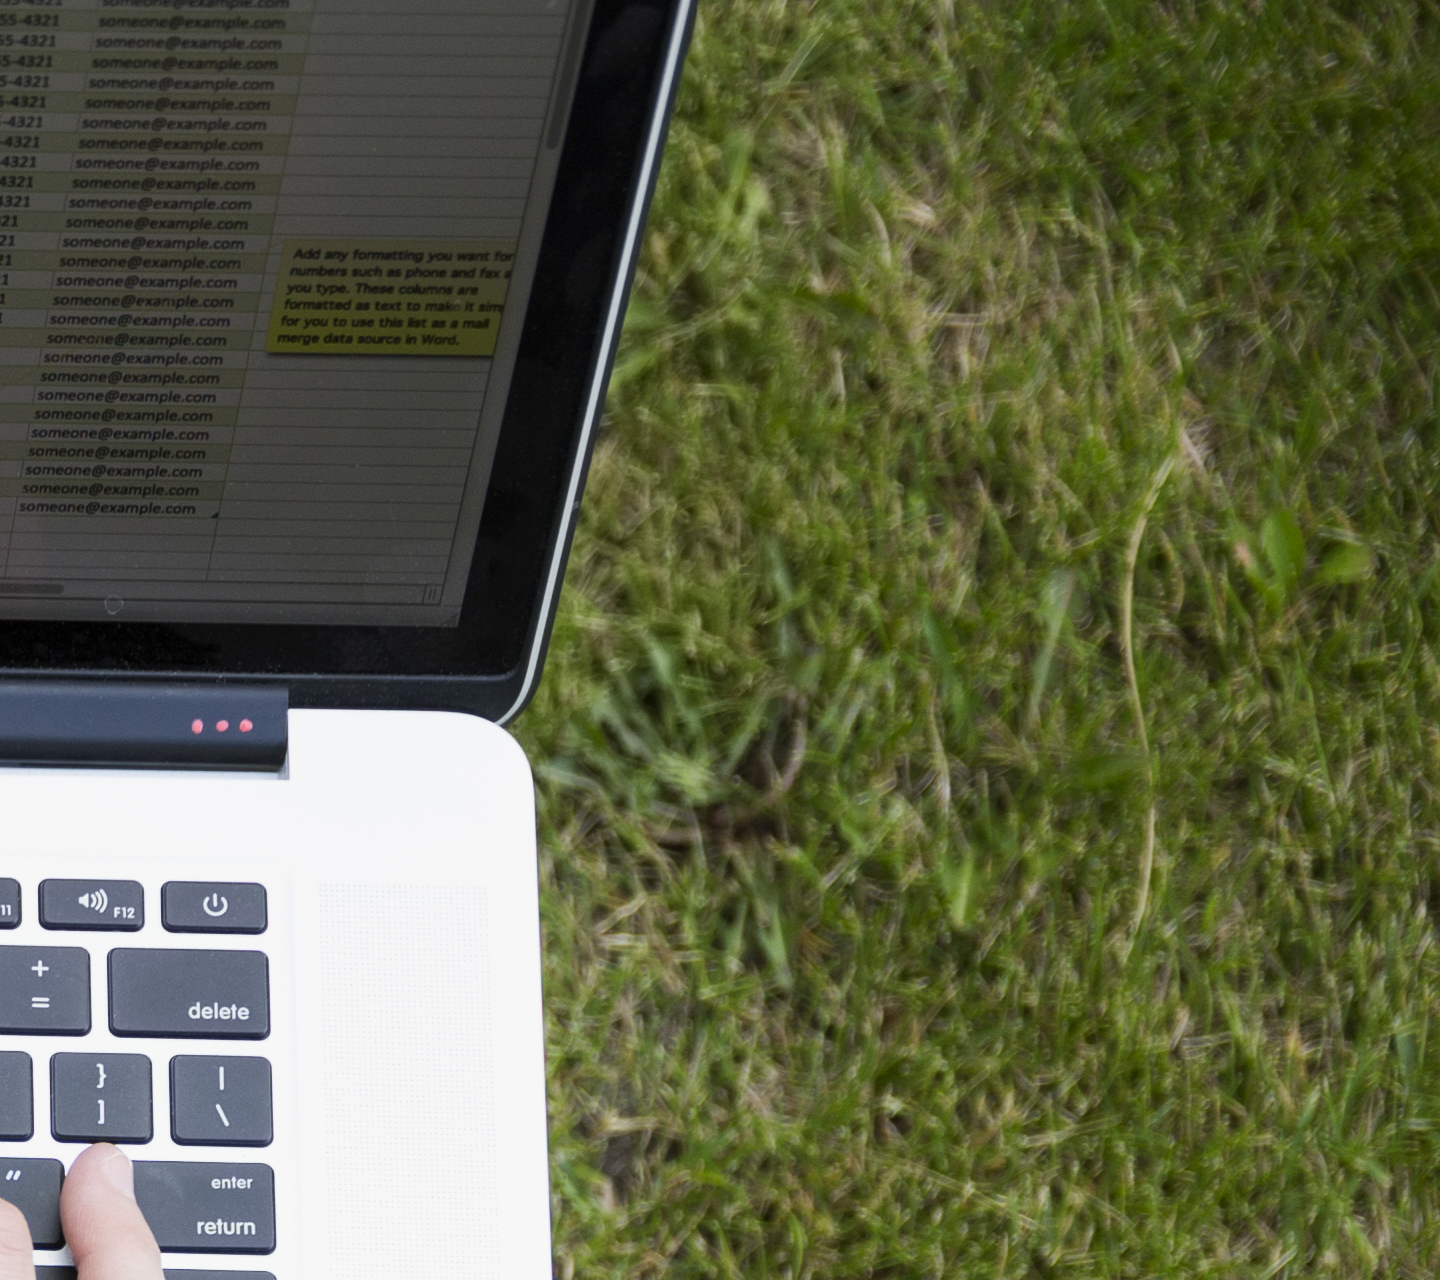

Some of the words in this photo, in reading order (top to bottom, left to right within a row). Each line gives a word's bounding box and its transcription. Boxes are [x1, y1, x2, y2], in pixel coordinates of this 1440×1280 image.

[92, 56, 278, 72] someone@example.com
[79, 138, 263, 153] someone@example.com
[293, 249, 321, 259] Add
[324, 251, 349, 262] any
[353, 249, 424, 263] formatting
[427, 252, 453, 263] you
[457, 252, 490, 261] want
[494, 250, 515, 262] for
[60, 256, 241, 271] someone@example.com
[290, 265, 347, 277] numbers
[352, 266, 383, 277] such
[386, 269, 402, 277] as
[405, 267, 447, 280] phone
[451, 268, 476, 278] and
[479, 267, 500, 279] fax
[286, 285, 312, 295] you
[316, 284, 349, 296] type.
[356, 283, 394, 294] These
[398, 284, 453, 295] columns
[457, 287, 478, 295] are
[284, 299, 352, 310] formatted
[355, 302, 370, 311] as
[375, 301, 402, 311] text
[406, 302, 421, 312] to
[464, 302, 474, 312] it
[281, 315, 301, 326] for
[303, 318, 329, 329] you
[333, 317, 347, 327] to
[351, 319, 374, 327] use
[379, 317, 403, 328] this
[407, 317, 427, 328] list
[431, 320, 446, 328] as
[450, 320, 459, 329] a
[462, 318, 490, 329] mail
[277, 334, 320, 346] merge
[323, 333, 353, 344] data
[357, 336, 401, 345] source
[405, 335, 417, 344] in
[422, 334, 459, 345] Word.
[20, 502, 196, 516] someone@example.com
[113, 906, 135, 919] F12
[187, 1001, 250, 1021] delete
[210, 1175, 254, 1190] enter
[196, 1218, 256, 1236] return
